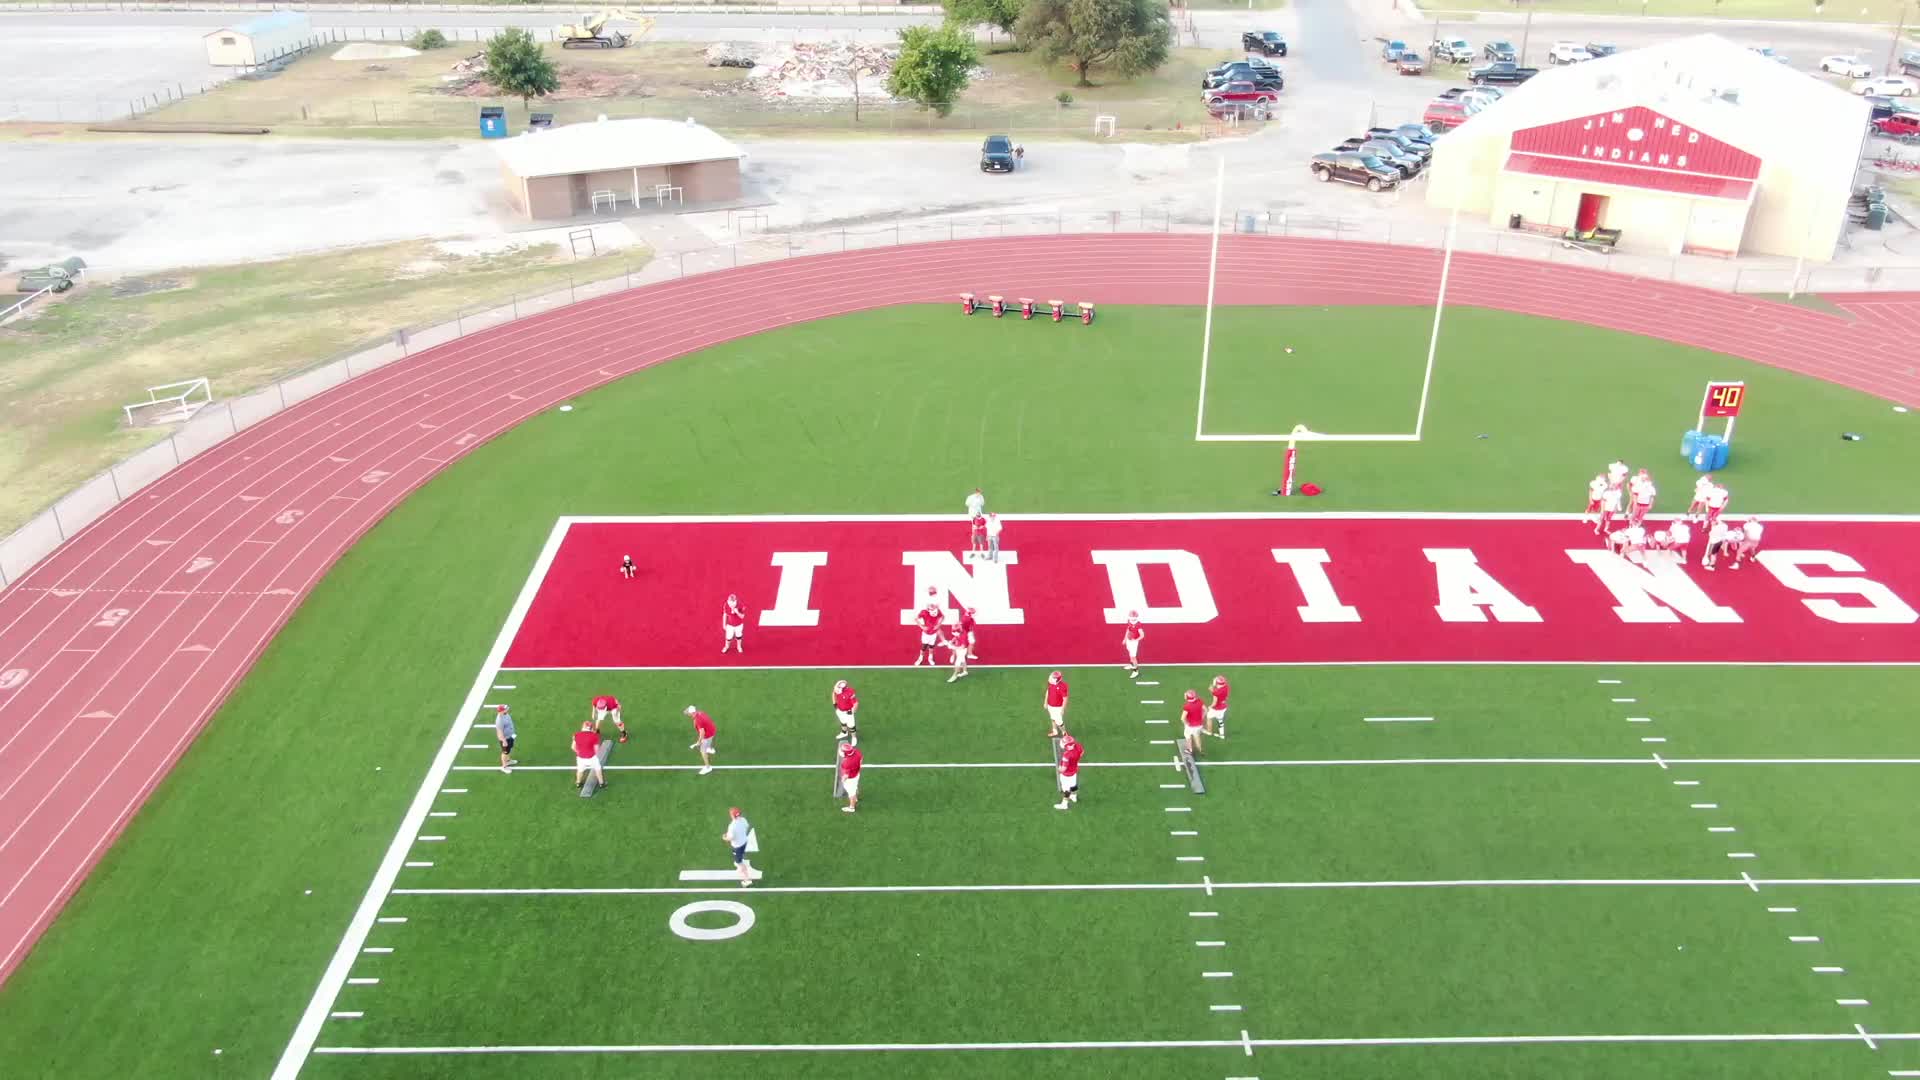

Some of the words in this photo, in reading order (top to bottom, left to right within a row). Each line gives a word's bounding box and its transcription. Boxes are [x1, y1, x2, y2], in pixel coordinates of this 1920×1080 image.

[1584, 112, 1624, 130] JIM
[1655, 117, 1699, 143] NED
[1582, 144, 1687, 167] INDIANS
[1713, 387, 1741, 407] 40
[758, 548, 1919, 626] INDIANS
